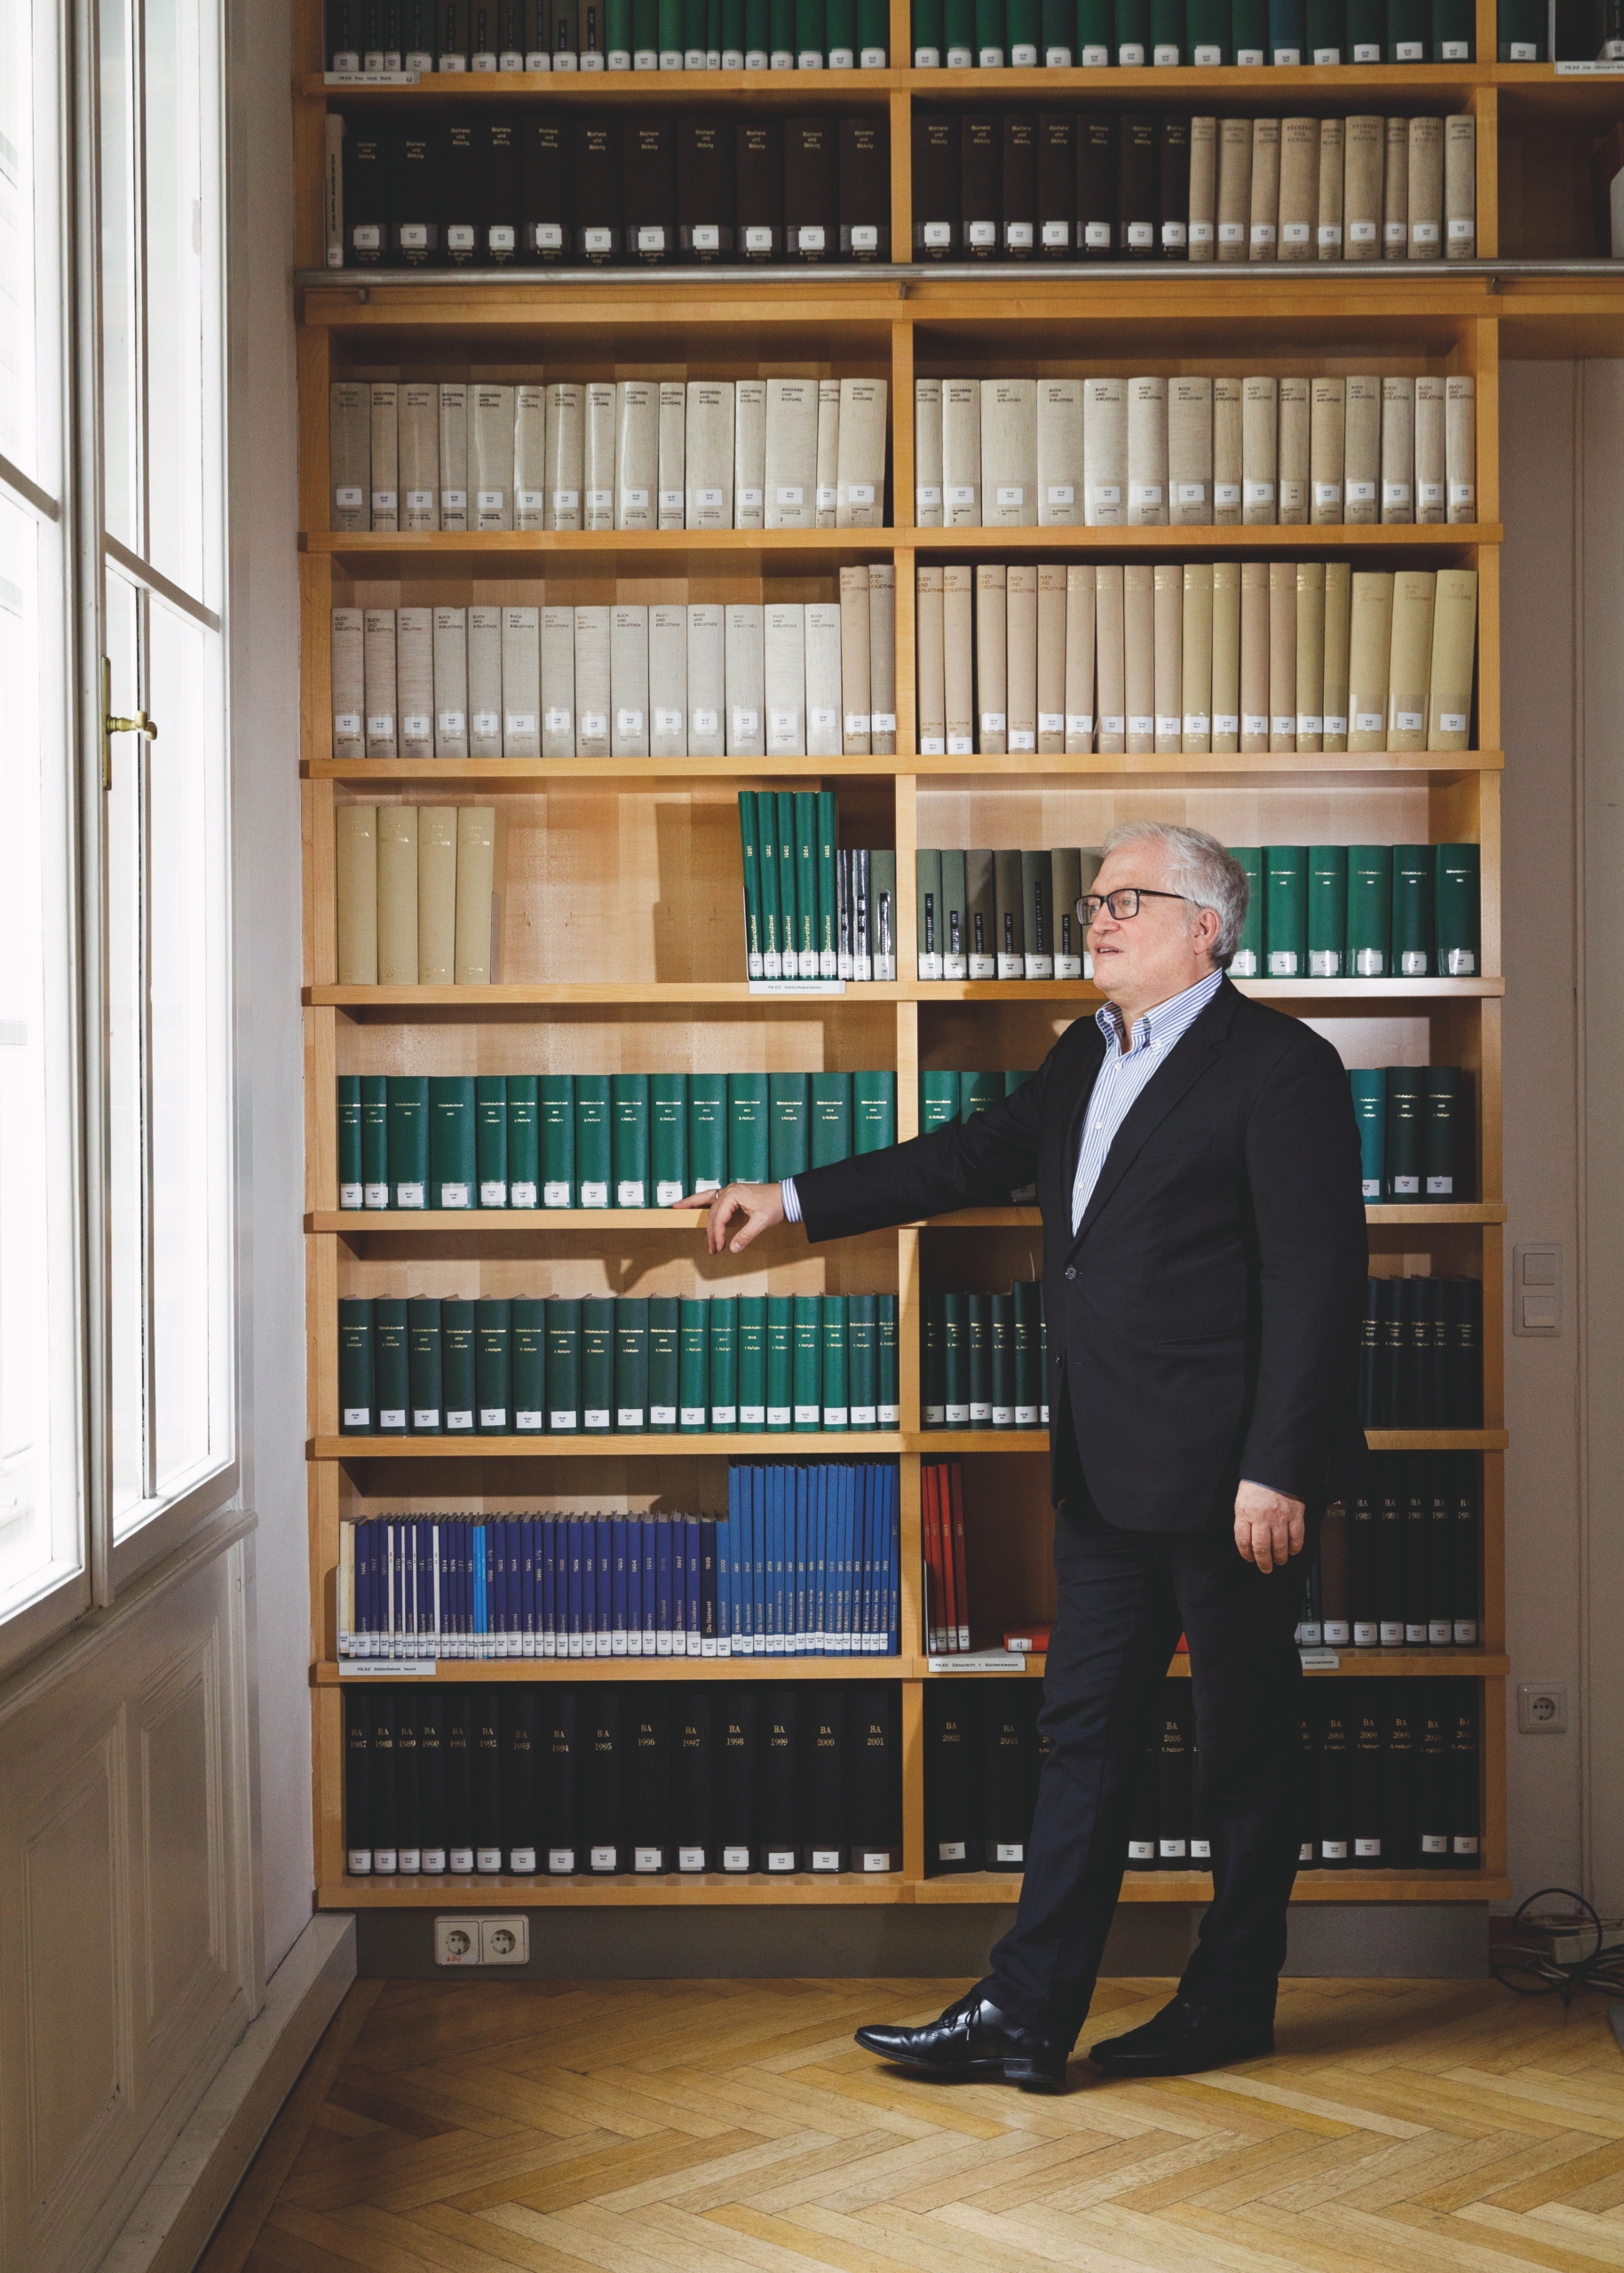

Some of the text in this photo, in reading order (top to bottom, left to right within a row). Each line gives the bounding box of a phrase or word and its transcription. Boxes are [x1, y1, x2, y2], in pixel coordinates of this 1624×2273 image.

[1357, 1499, 1368, 1508] BA
[1166, 1722, 1178, 1730] BA
[1363, 1718, 1374, 1727] BA
[1396, 1718, 1407, 1727] BA
[1427, 1720, 1439, 1729] BA
[401, 1727, 413, 1736] BA
[482, 1727, 494, 1736] BA
[515, 1730, 527, 1739] BA
[1327, 1731, 1345, 1740] 2008
[376, 1739, 393, 1748] 1988
[422, 1739, 440, 1748] 1990
[638, 1738, 655, 1746] 1996
[682, 1738, 701, 1747] 1997
[770, 1738, 788, 1746] 1999
[1000, 1737, 1018, 1746] 2003
[594, 1742, 613, 1751] 1995
